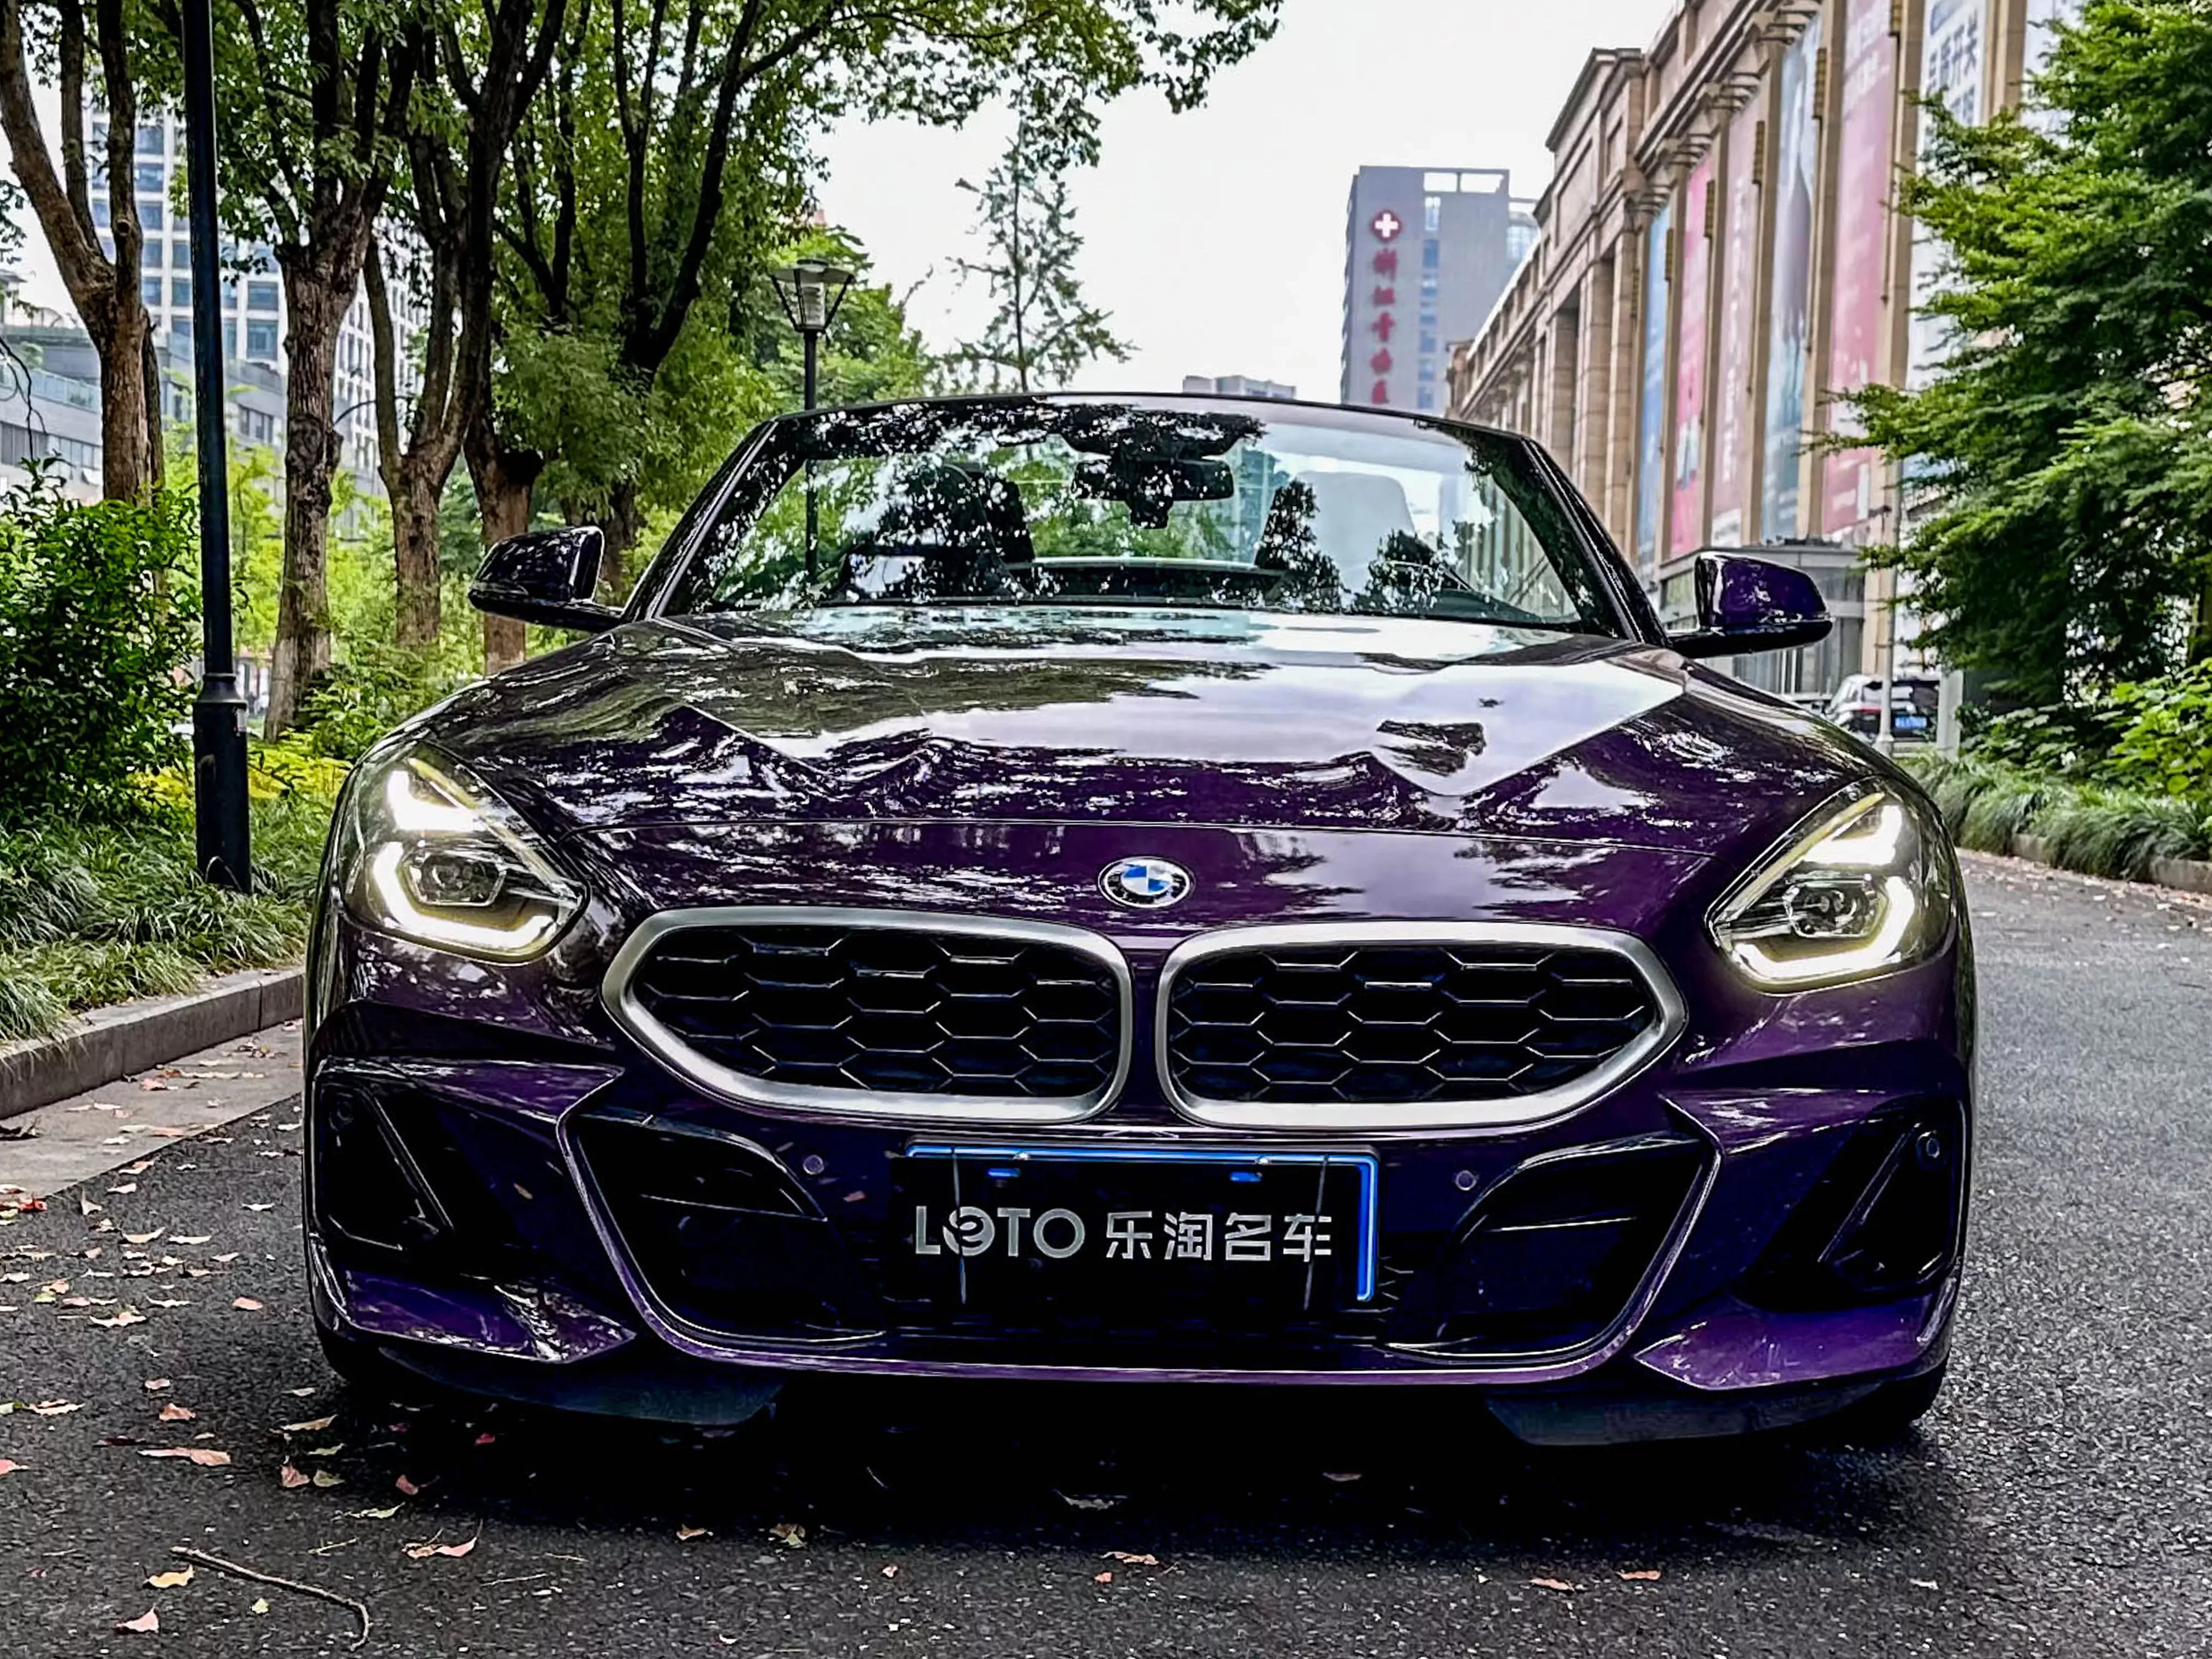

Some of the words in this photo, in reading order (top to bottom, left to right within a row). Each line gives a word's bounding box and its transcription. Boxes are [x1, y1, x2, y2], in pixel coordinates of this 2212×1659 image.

[915, 1205, 1086, 1259] LOTO
[1105, 1210, 1333, 1263] 乐淘名车
